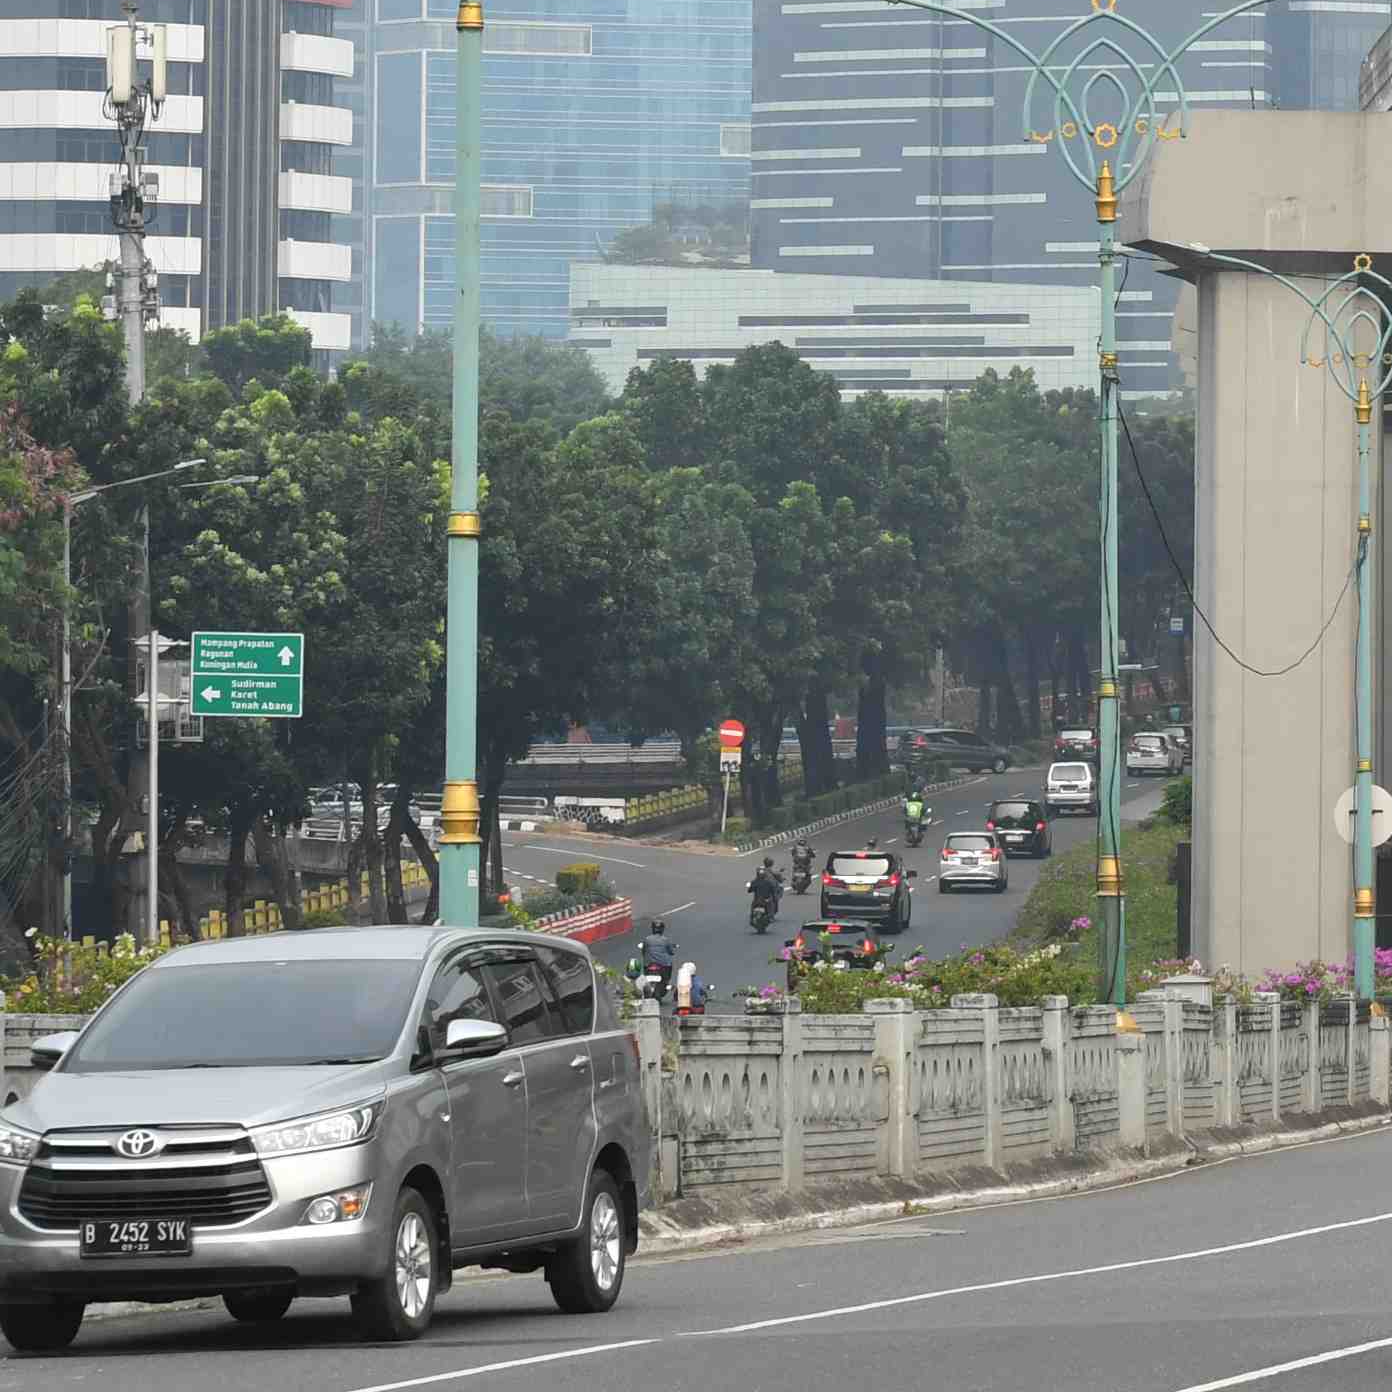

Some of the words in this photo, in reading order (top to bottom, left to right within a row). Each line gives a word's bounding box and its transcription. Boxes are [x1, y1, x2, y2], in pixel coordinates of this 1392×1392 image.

[200, 639, 238, 649] Mampang
[239, 640, 275, 650] Prapatan
[200, 649, 234, 660] Ragunan
[231, 679, 277, 689] Sudirman
[231, 690, 258, 699] Karet
[231, 701, 260, 710] Tanah
[261, 702, 293, 712] Abang
[85, 1223, 95, 1244] B
[109, 1222, 150, 1243] 2452
[157, 1220, 186, 1241] SYK
